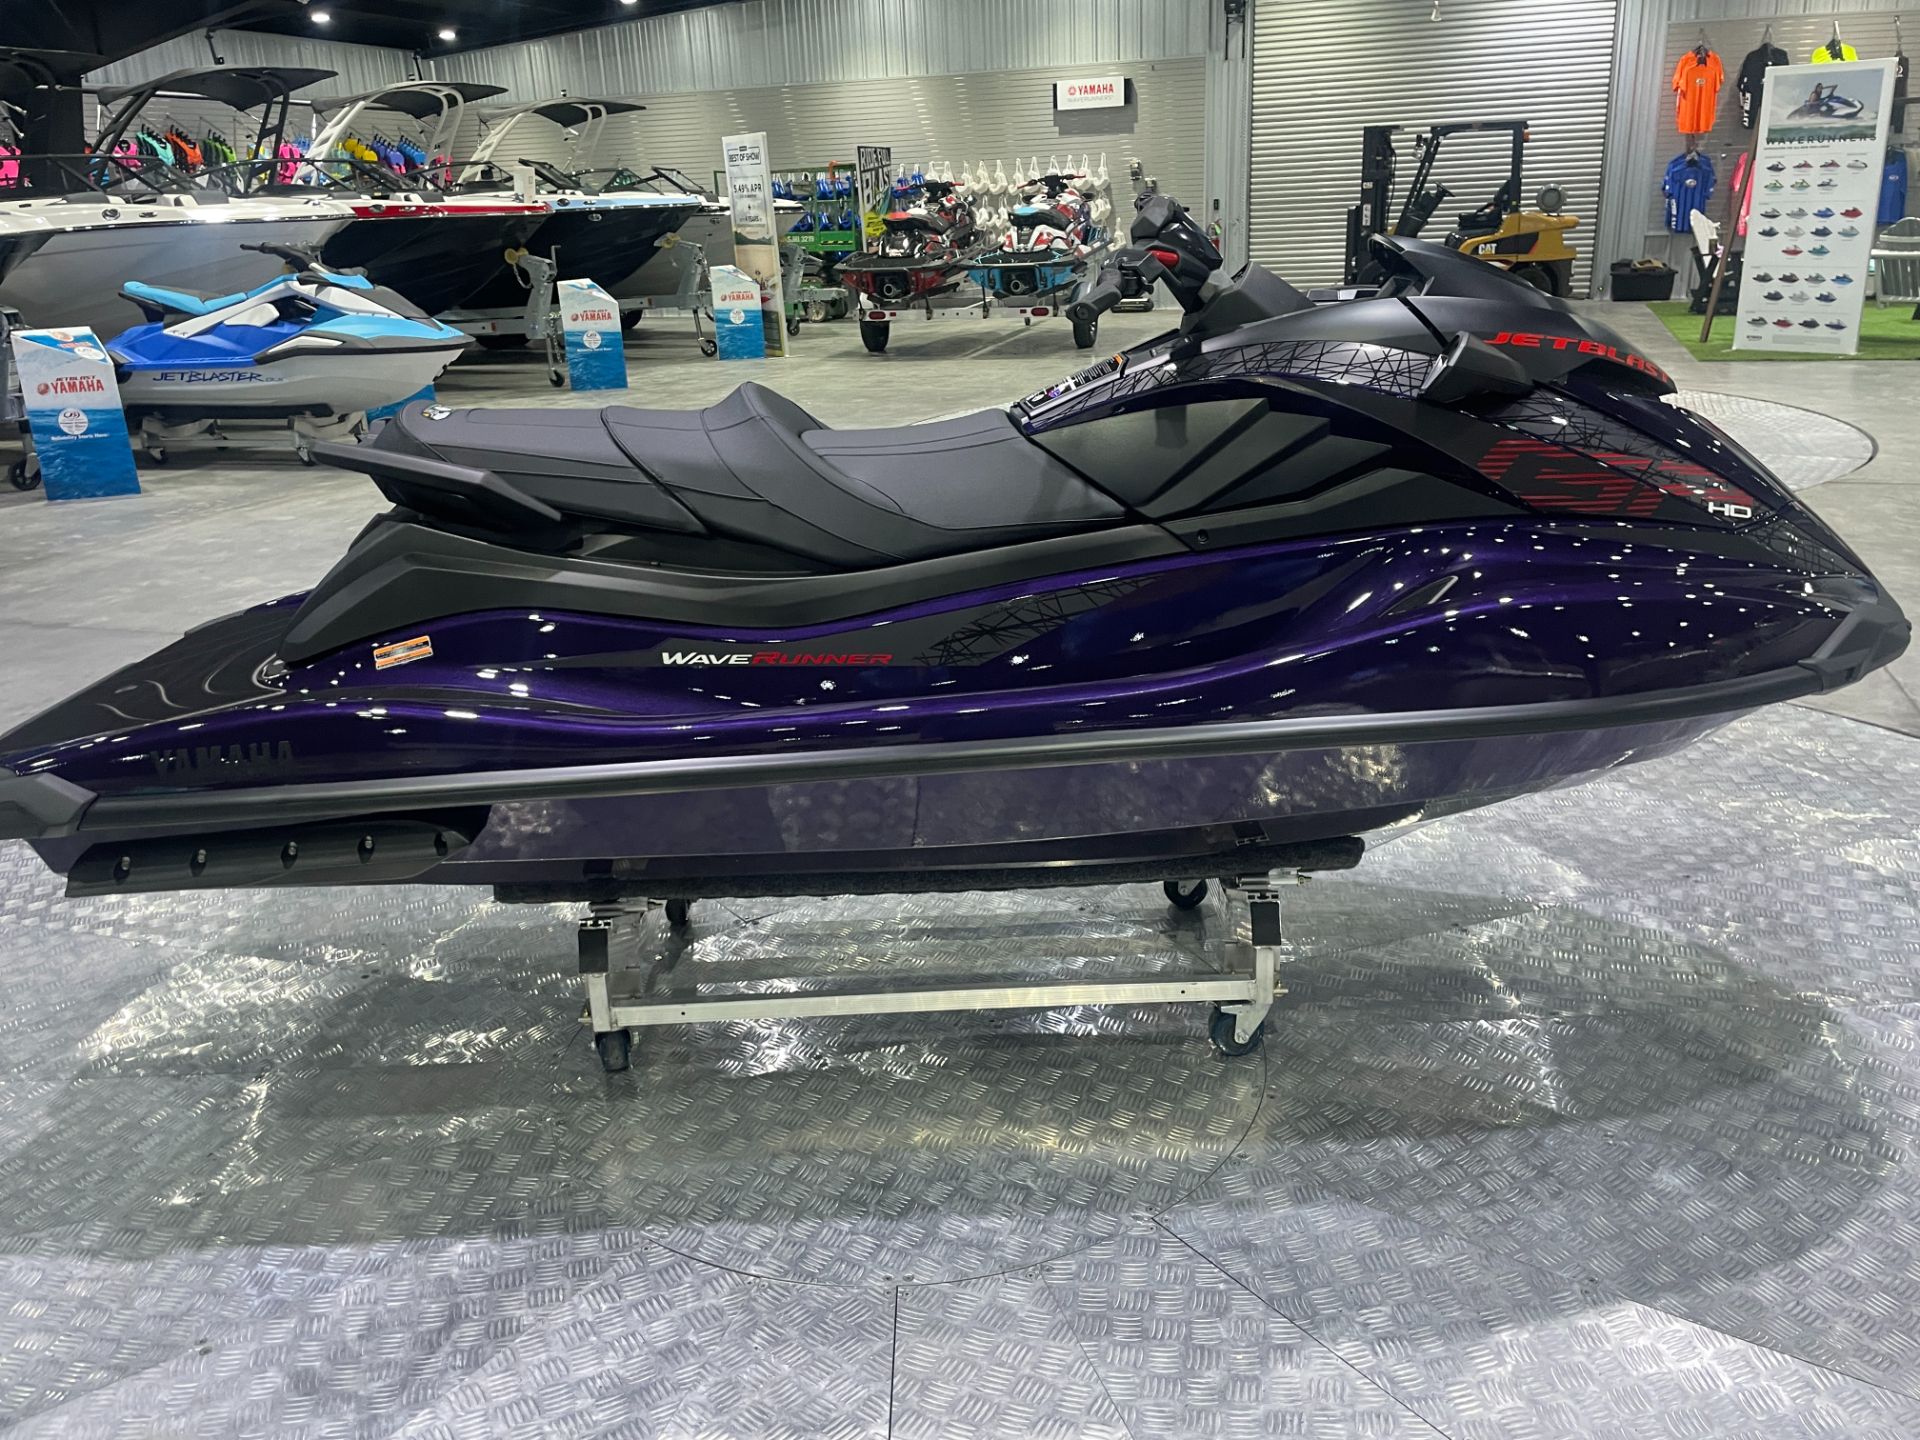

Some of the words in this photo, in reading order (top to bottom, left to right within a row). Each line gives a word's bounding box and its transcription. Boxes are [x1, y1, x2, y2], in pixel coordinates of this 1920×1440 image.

[1078, 83, 1114, 95] YAMAHA
[750, 183, 762, 192] APR
[1478, 243, 1497, 255] CAT
[728, 293, 754, 301] YAMAHA
[580, 312, 612, 321] YAMAHA
[1484, 331, 1669, 384] JETBLAST
[152, 370, 264, 383] JETBLASTER
[50, 379, 105, 394] YAMAHA
[149, 740, 295, 782] YAMAHA
